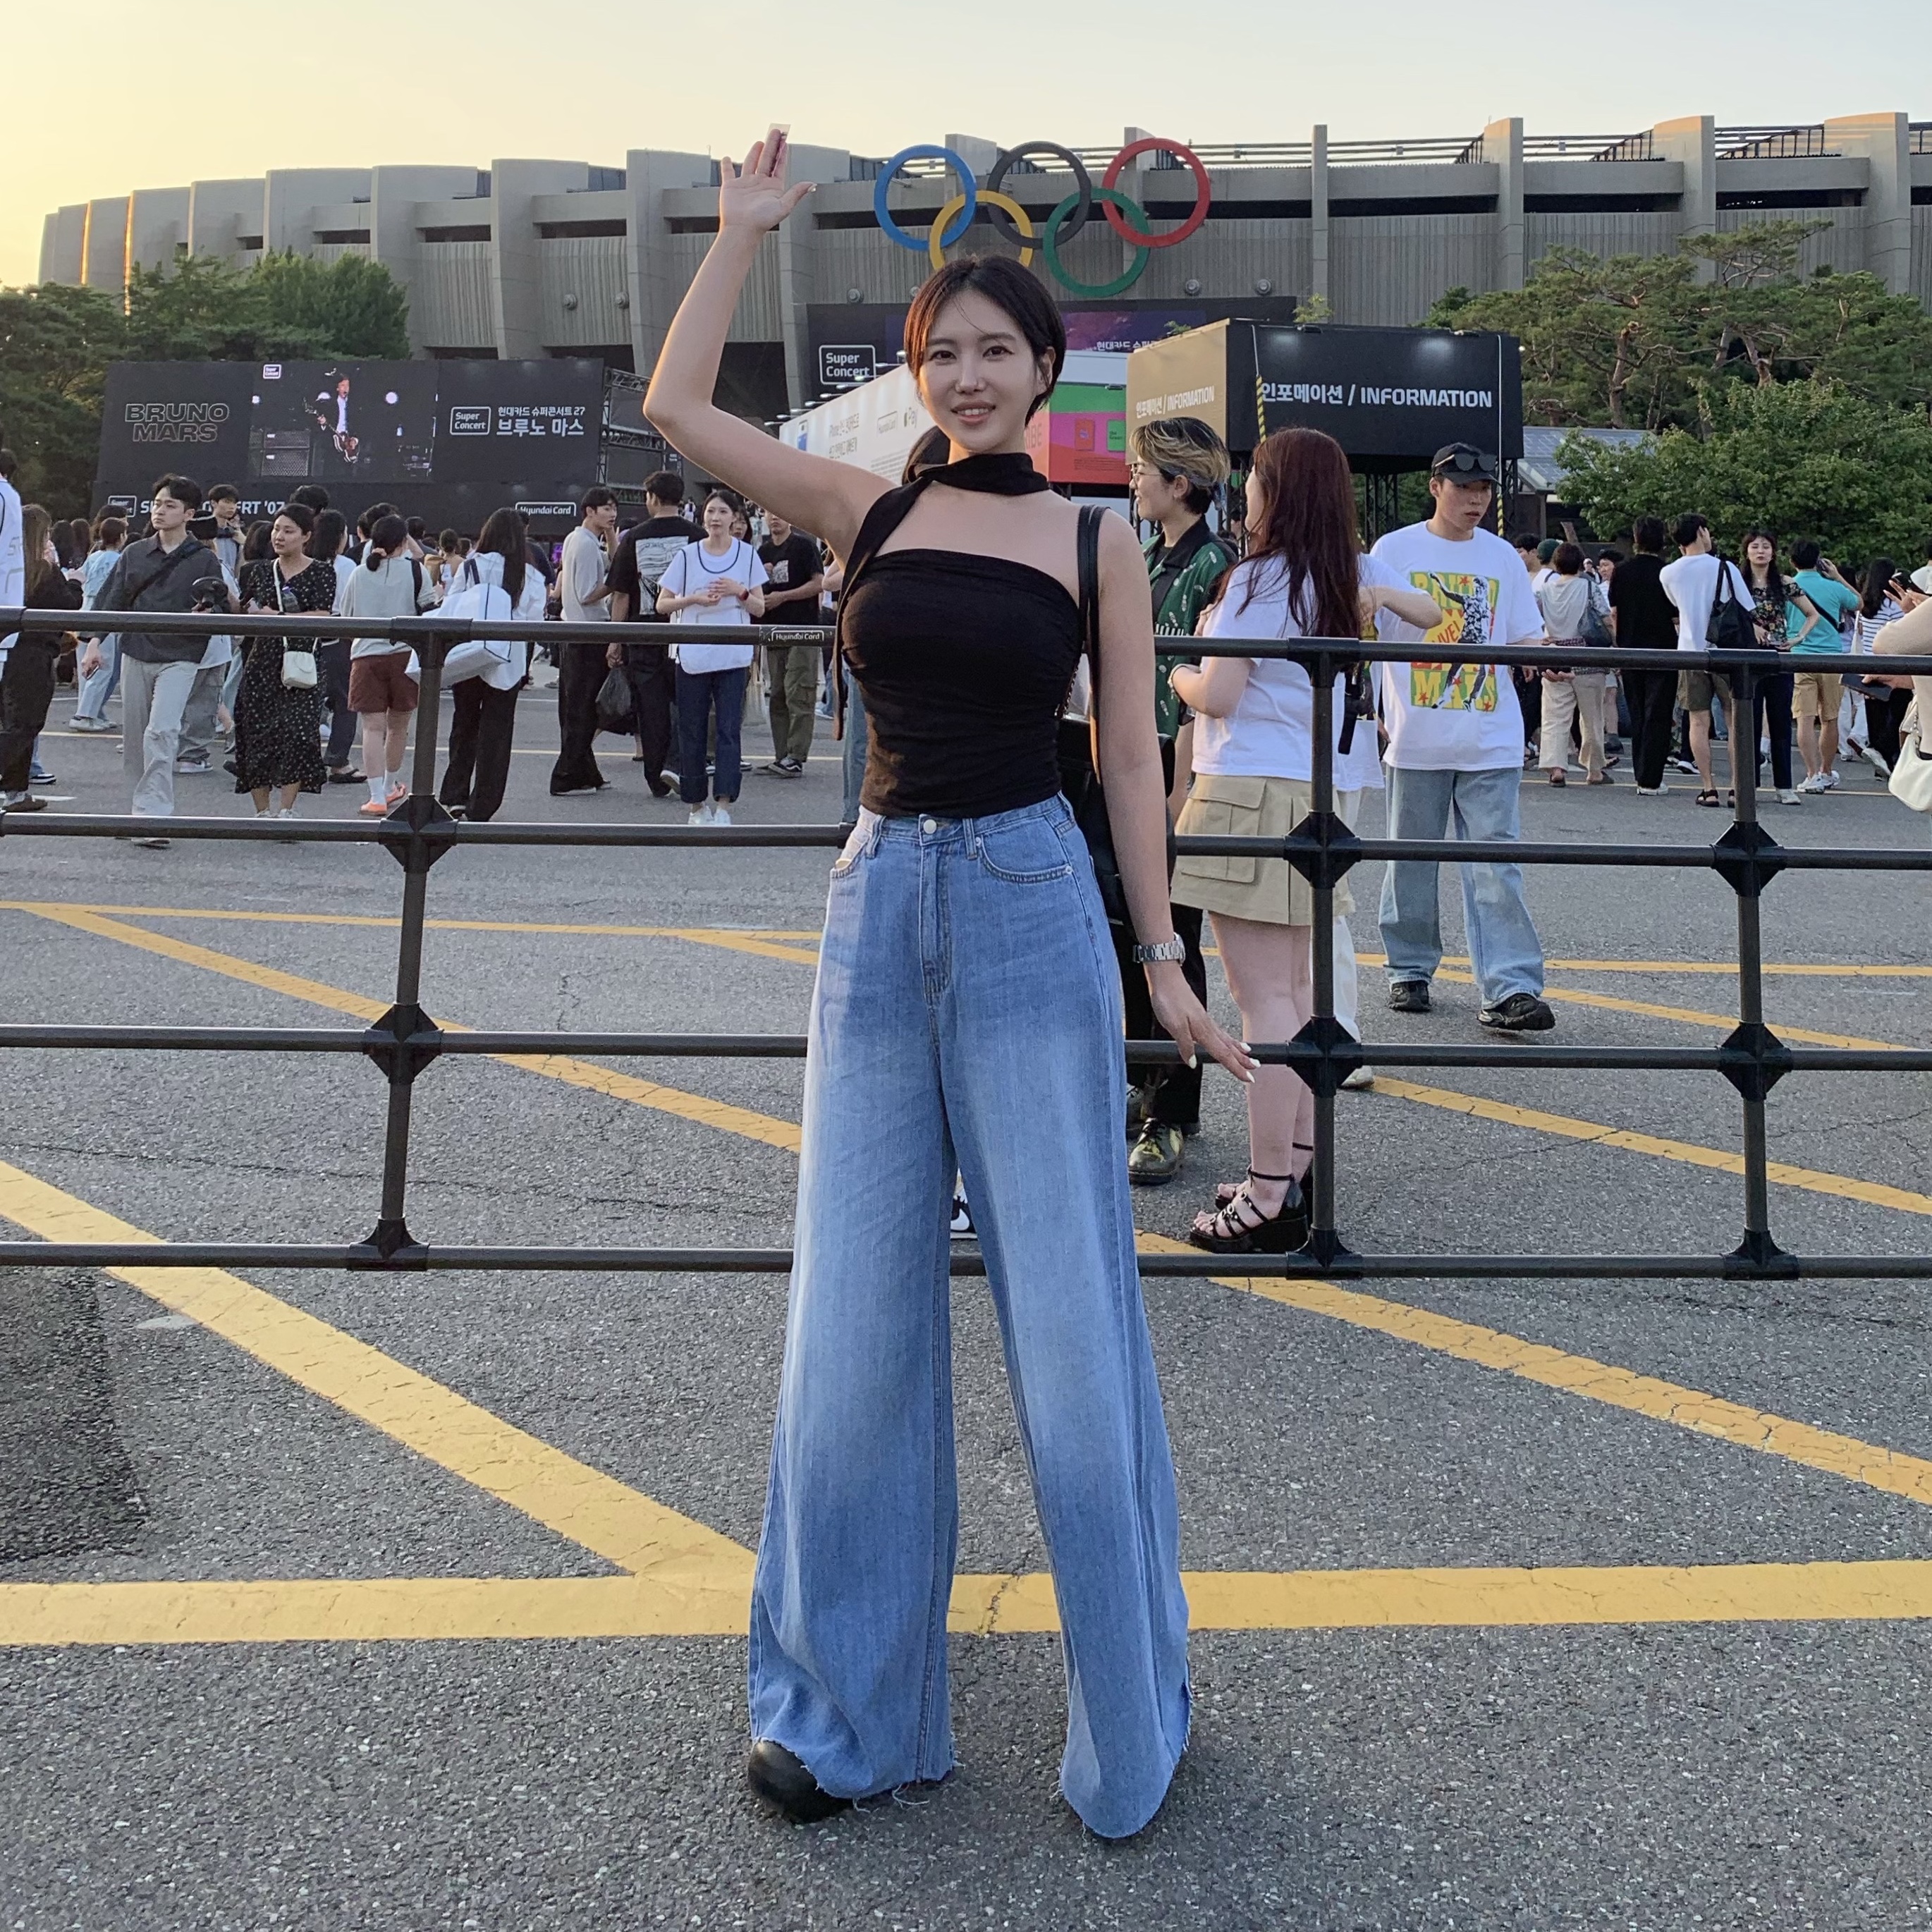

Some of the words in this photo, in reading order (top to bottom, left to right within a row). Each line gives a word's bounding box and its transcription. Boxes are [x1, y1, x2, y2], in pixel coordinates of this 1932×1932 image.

[826, 353, 860, 366] Super
[826, 366, 870, 378] Concert
[1168, 385, 1215, 412] INFORMATION
[1261, 383, 1343, 404] 인포메이션
[1347, 384, 1356, 407] /
[1361, 387, 1492, 408] INFORMATION
[125, 403, 229, 422] BRUNO
[455, 412, 480, 422] Super
[498, 406, 530, 417] 현대카드
[531, 406, 573, 417] 슈퍼콘서트
[573, 406, 585, 416] 27
[454, 421, 487, 430] Concert
[496, 418, 546, 437] 브루노
[551, 417, 585, 438] 마스
[133, 423, 218, 442] MARS
[553, 506, 572, 515] Card
[776, 632, 804, 641] Hyundai
